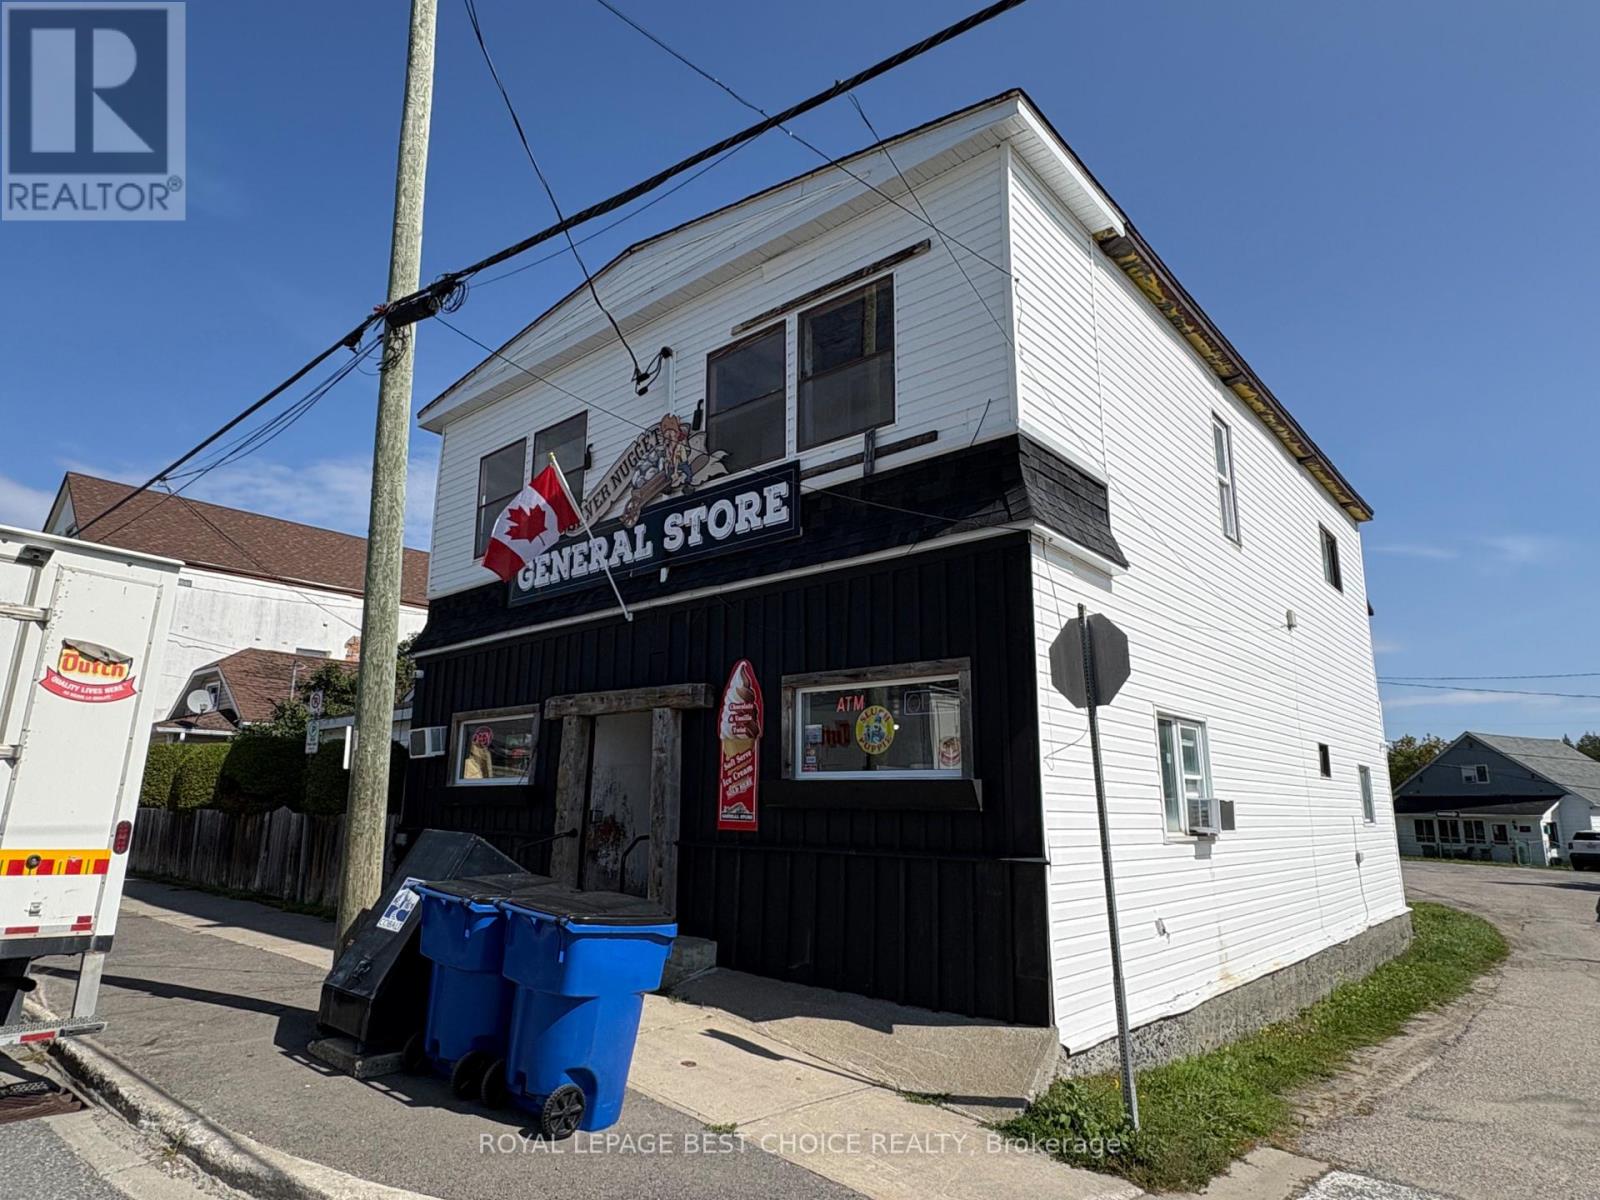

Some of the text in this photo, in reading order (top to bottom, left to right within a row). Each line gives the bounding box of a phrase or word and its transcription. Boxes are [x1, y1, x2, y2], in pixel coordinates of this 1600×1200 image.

[610, 428, 663, 490] NUGGET
[517, 481, 790, 591] GENERAL STORE
[836, 695, 865, 712] ATM
